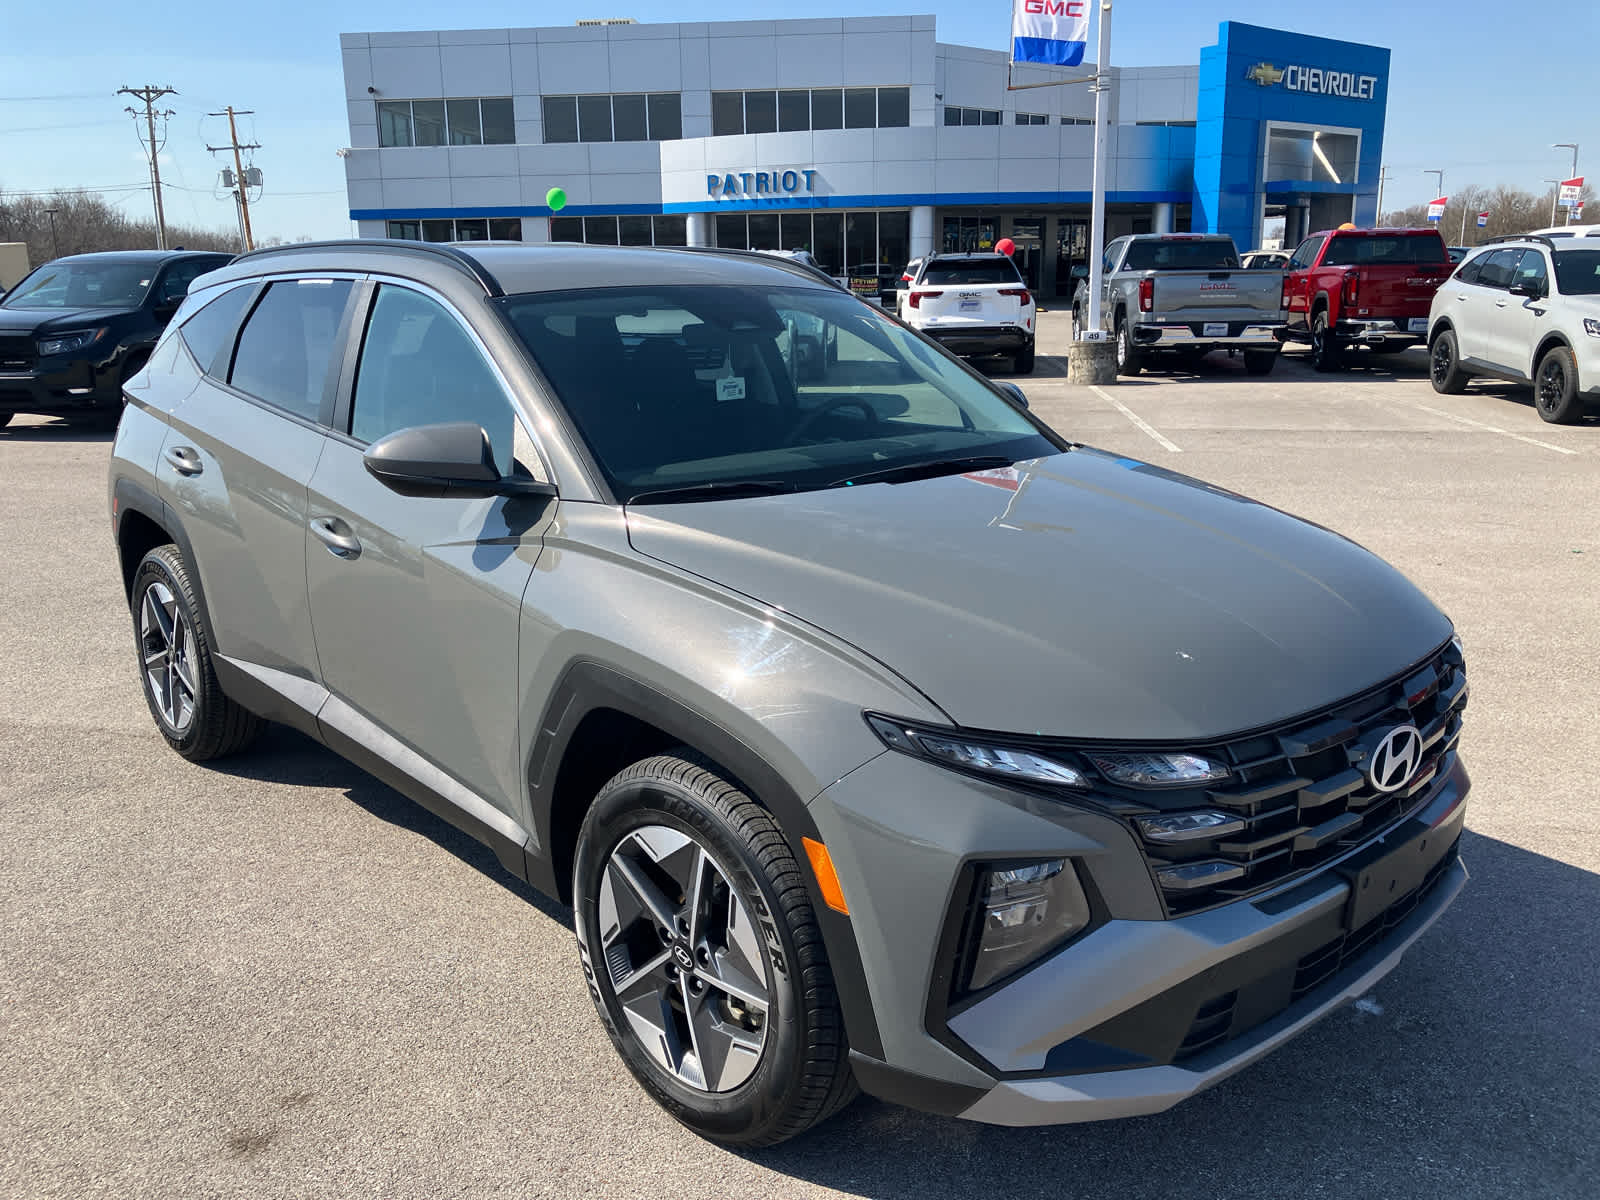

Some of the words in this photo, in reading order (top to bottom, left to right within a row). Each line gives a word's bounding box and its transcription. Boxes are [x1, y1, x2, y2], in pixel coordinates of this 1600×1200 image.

[1025, 0, 1083, 17] GMC
[1287, 65, 1377, 99] CHEVROLET
[707, 169, 816, 195] PATRIOT
